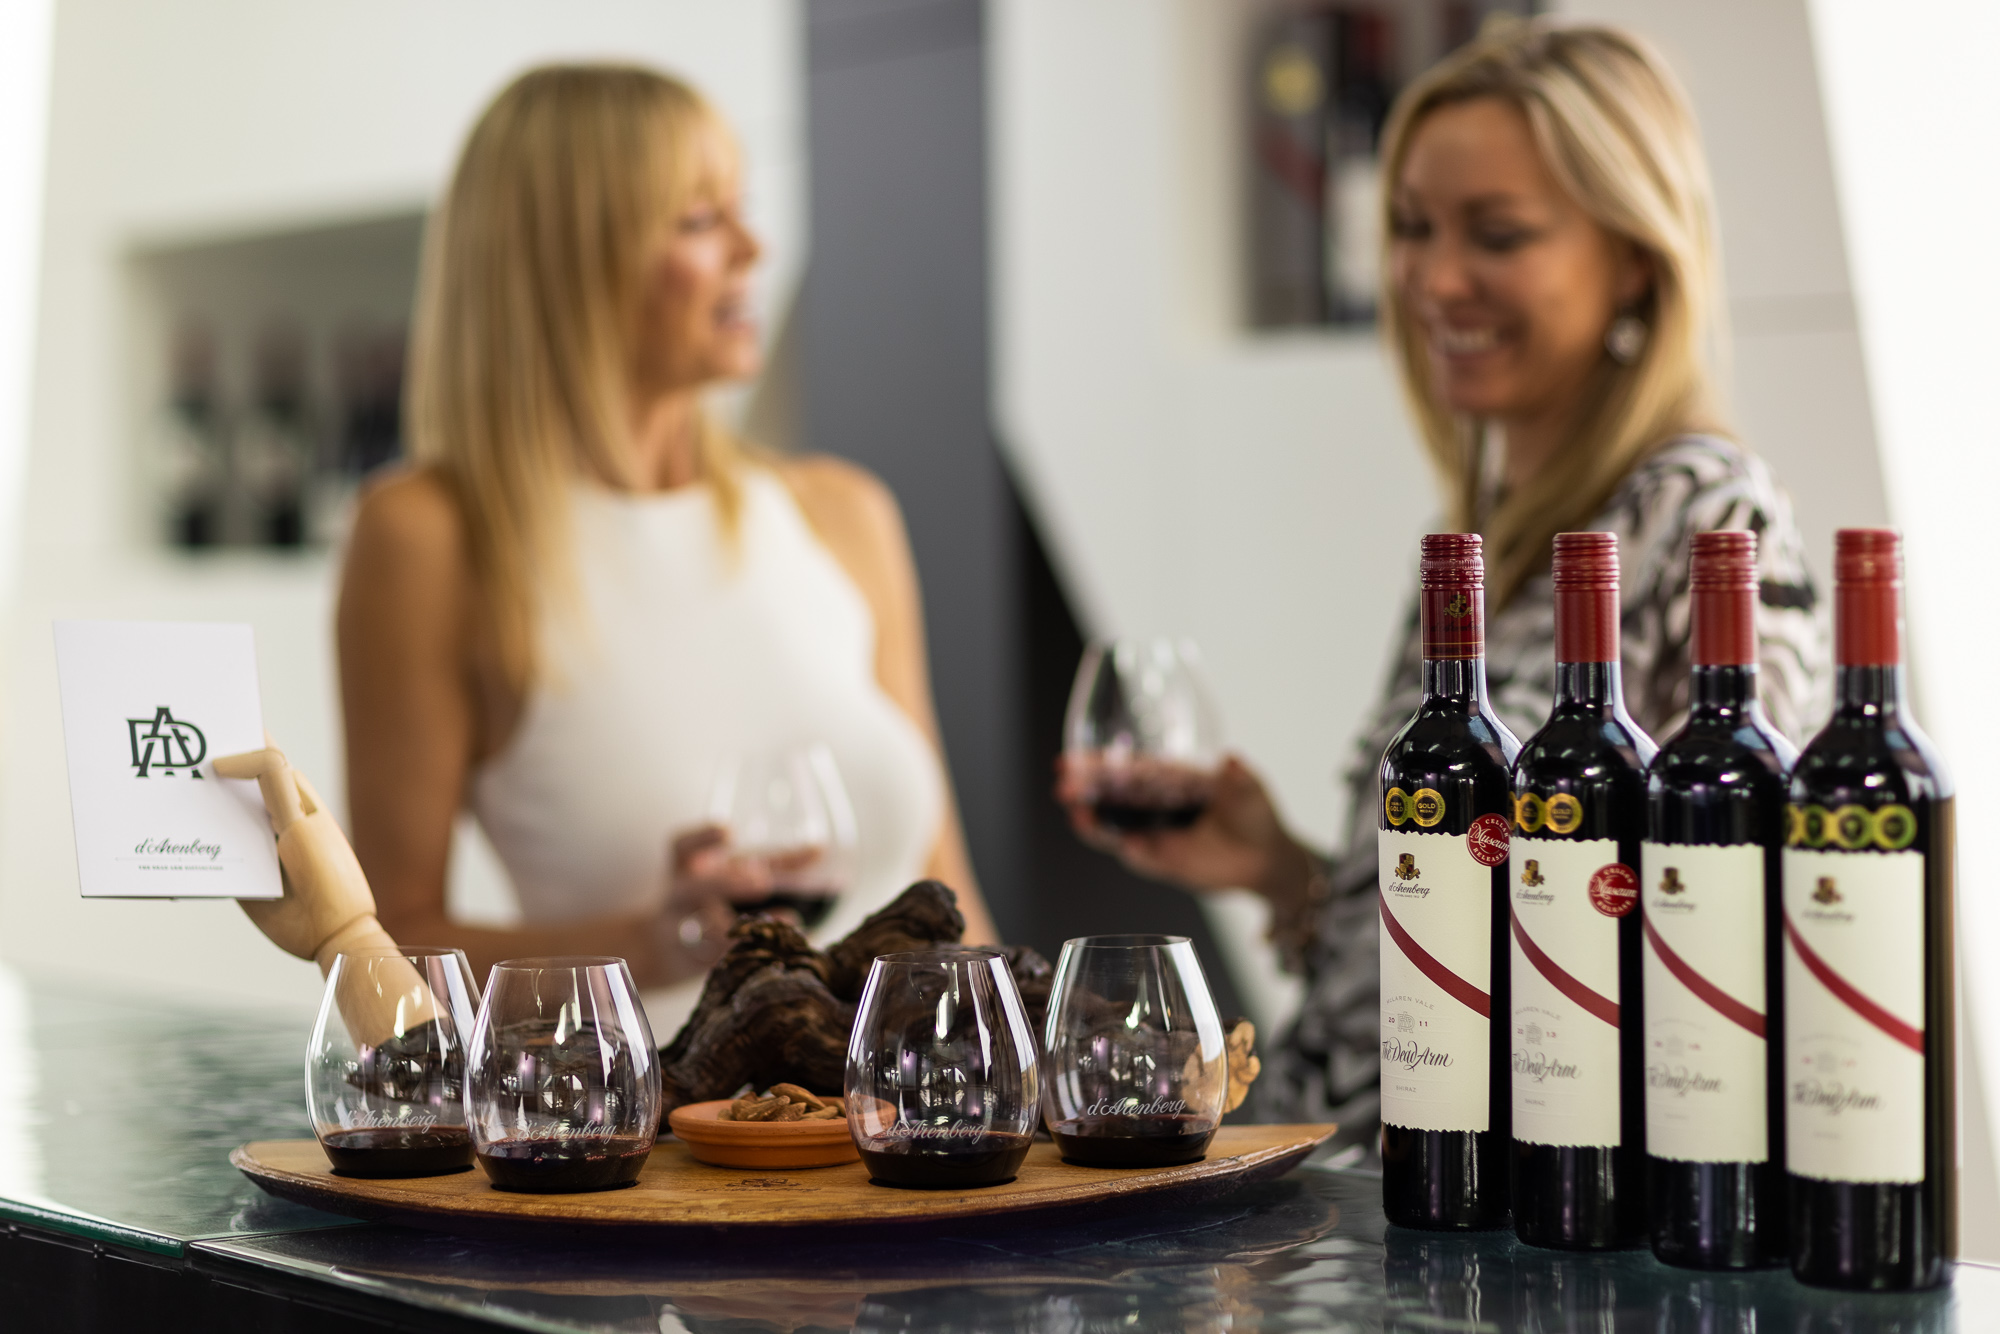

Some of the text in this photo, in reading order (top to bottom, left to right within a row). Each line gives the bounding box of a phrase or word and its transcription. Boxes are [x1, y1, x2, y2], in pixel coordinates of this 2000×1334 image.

[1470, 822, 1510, 852] Museum
[1484, 818, 1509, 838] CELLAR
[134, 837, 222, 861] d'Arenberg
[1473, 847, 1505, 862] RELEASE
[1388, 881, 1431, 899] d'Arenberg
[1414, 998, 1435, 1011] VALE
[1389, 1036, 1418, 1064] Dead
[1403, 1046, 1454, 1073] Arm
[1395, 1084, 1417, 1093] SHIRAZ
[1087, 1094, 1187, 1118] d'Arenberg
[339, 1108, 438, 1134] d'Arenberg
[516, 1120, 618, 1143] d'Arenberg
[886, 1119, 987, 1145] d'Arenberg
